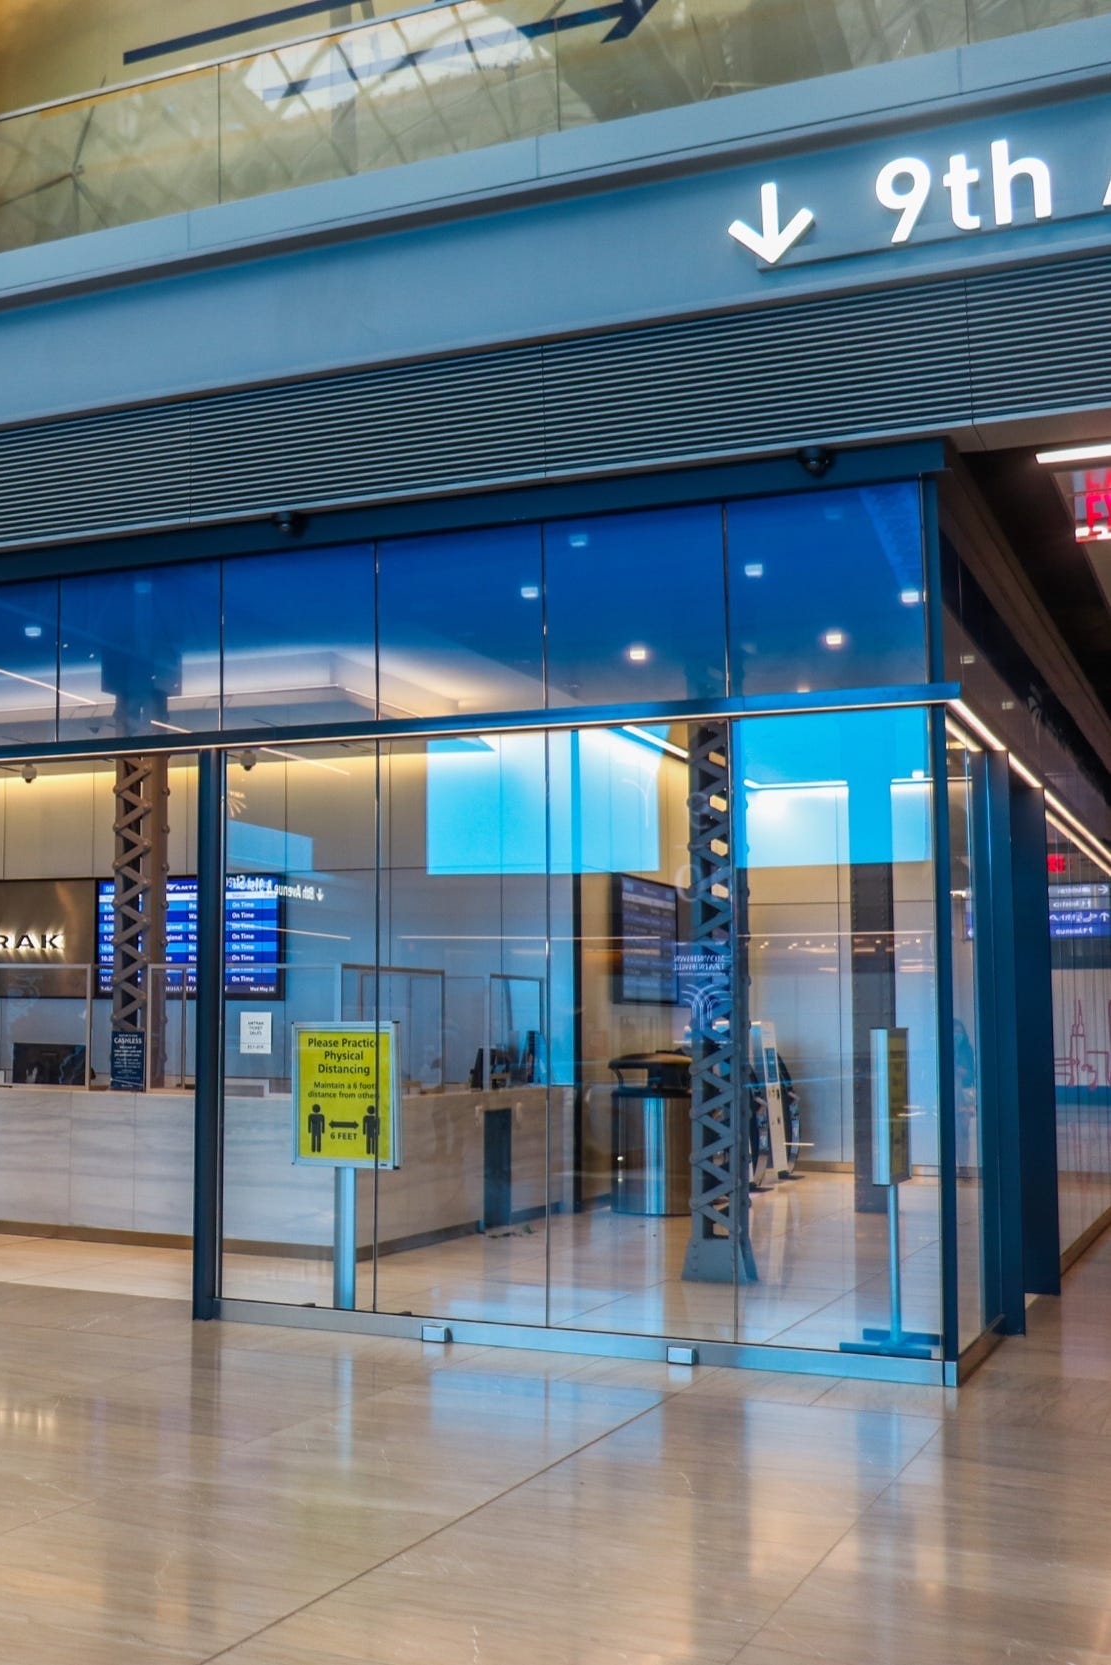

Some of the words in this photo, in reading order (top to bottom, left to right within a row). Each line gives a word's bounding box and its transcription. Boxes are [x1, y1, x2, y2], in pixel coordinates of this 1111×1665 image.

[875, 139, 1053, 244] 9th
[308, 1038, 339, 1047] Please
[341, 1038, 378, 1048] Practic
[324, 1050, 364, 1062] Physical
[318, 1063, 370, 1076] Distancing
[313, 1081, 345, 1089] Maintain
[338, 1091, 356, 1099] from
[357, 1091, 380, 1099] othe
